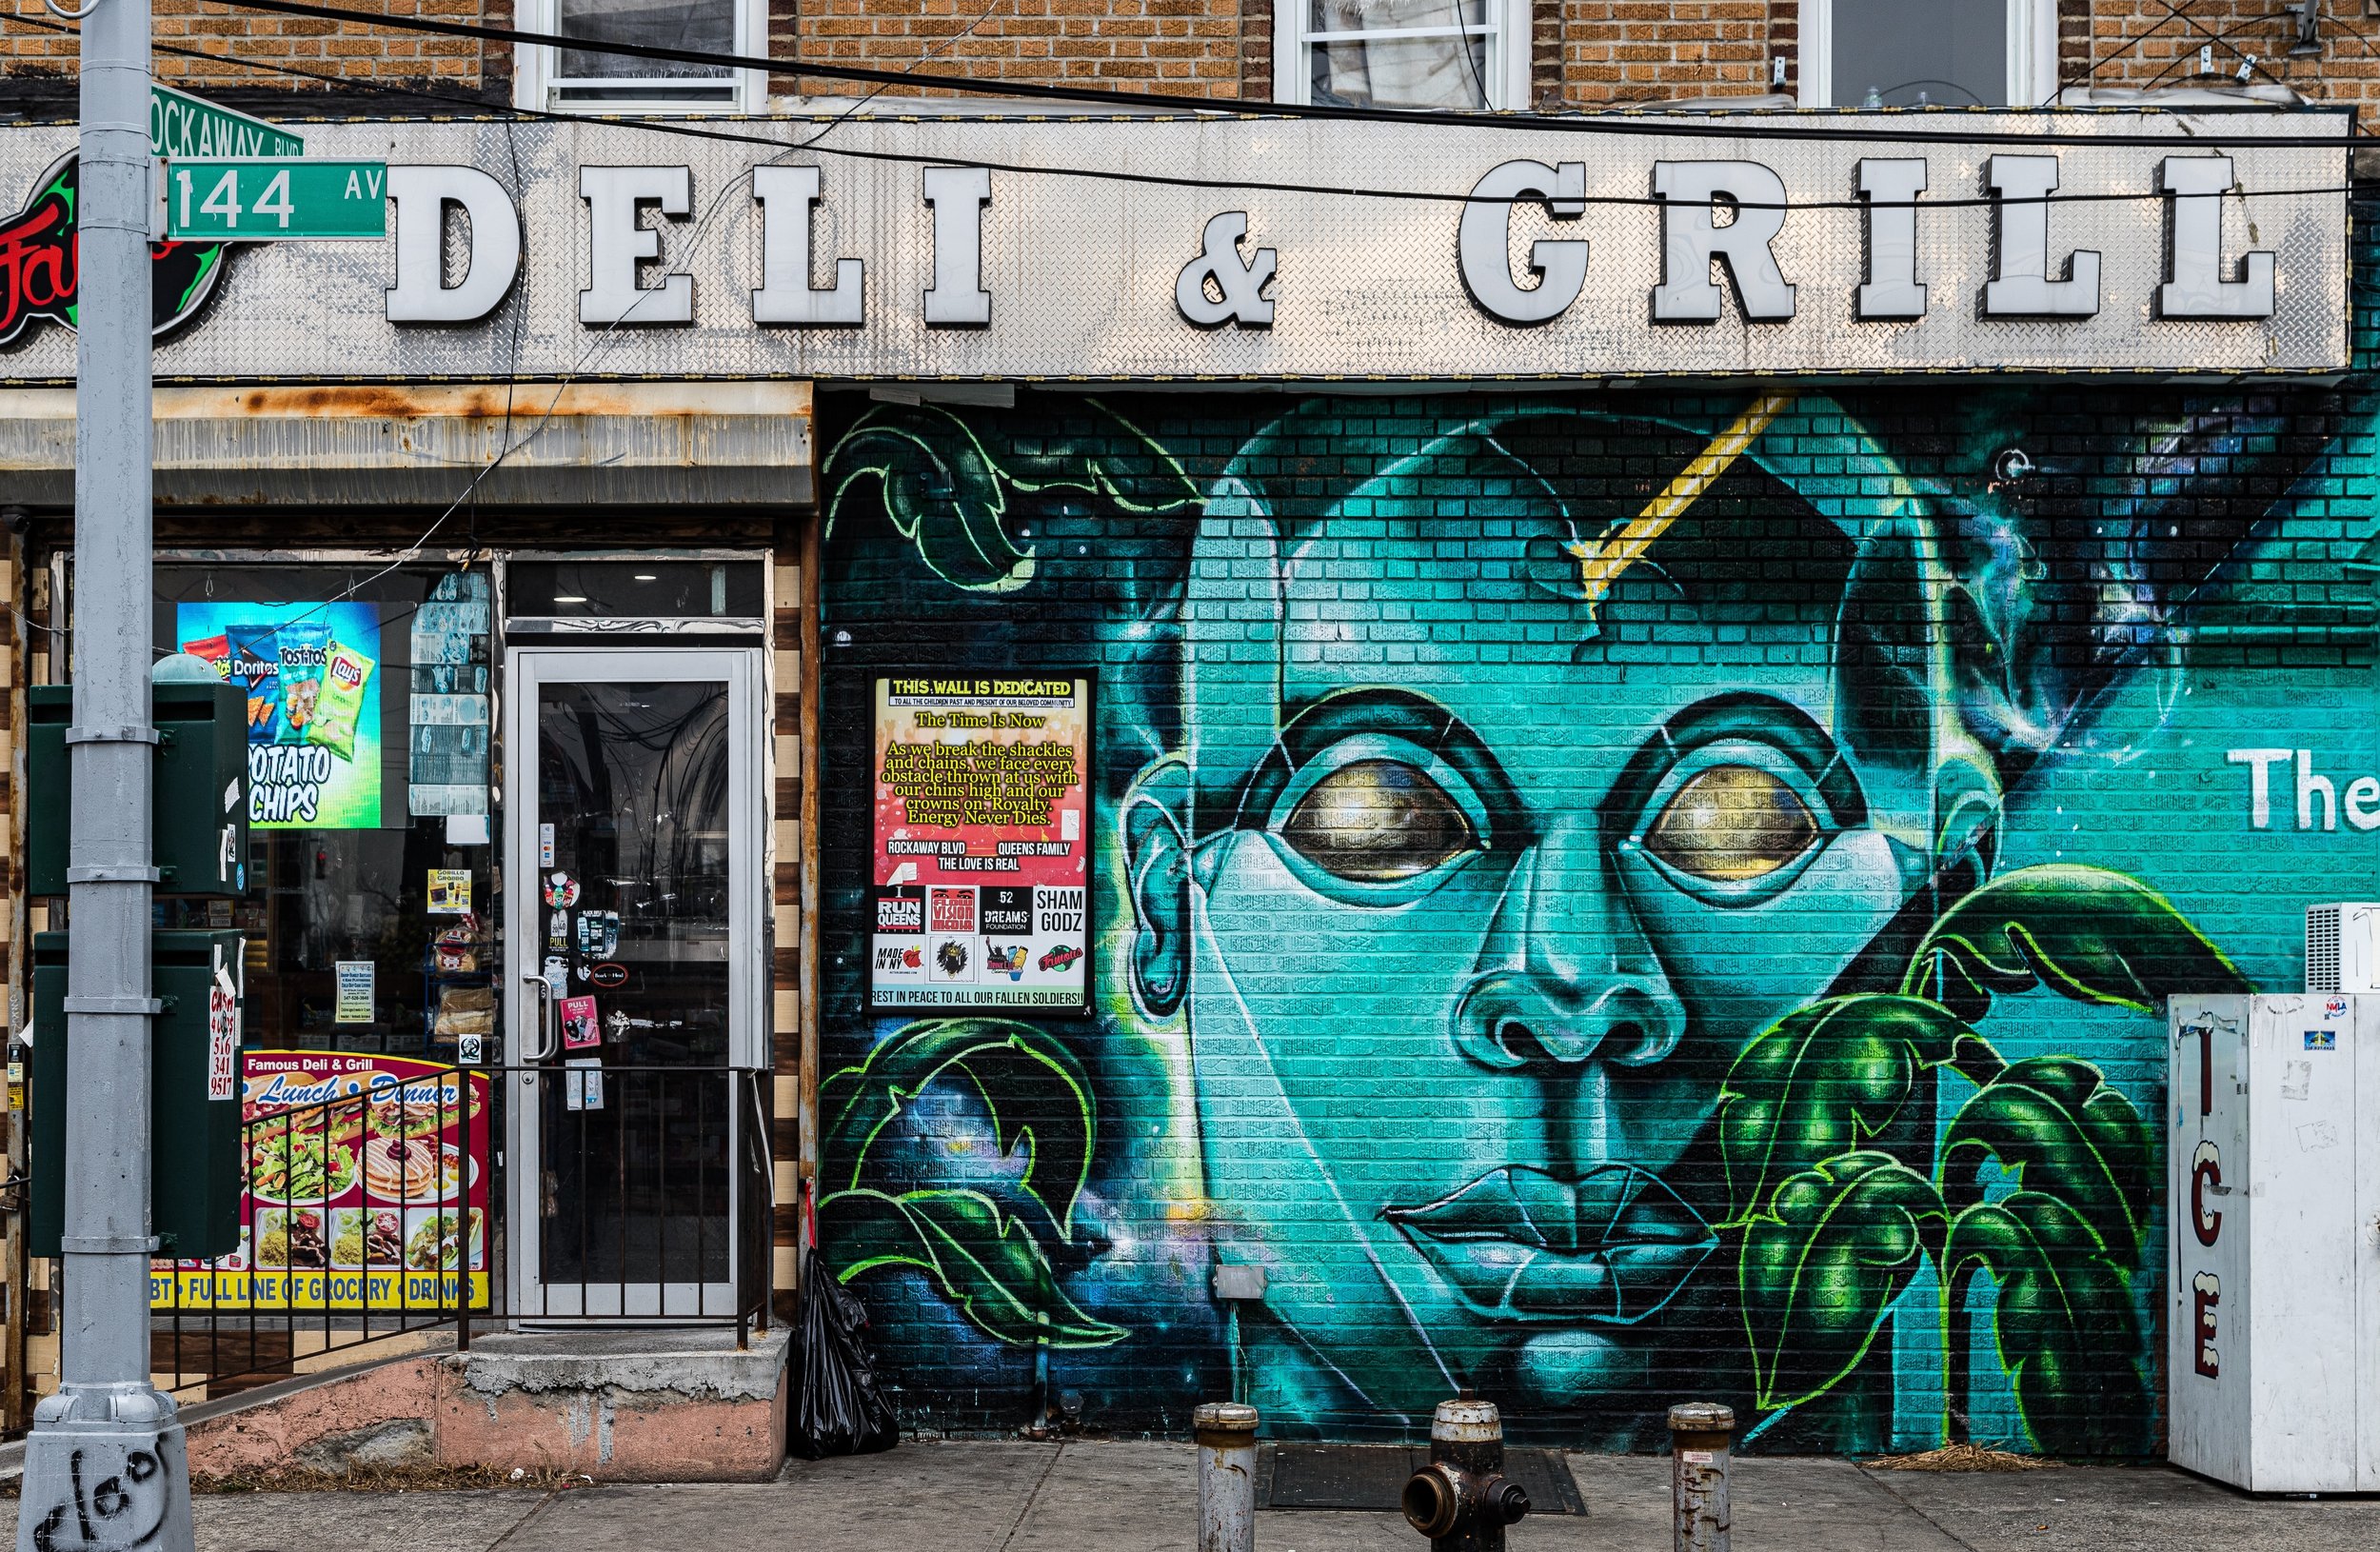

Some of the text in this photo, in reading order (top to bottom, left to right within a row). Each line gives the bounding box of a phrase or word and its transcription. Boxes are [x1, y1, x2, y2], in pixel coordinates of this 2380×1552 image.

[151, 93, 299, 156] OCKAWAY BLVD
[176, 169, 382, 228] 144 AV
[385, 154, 2276, 327] DELI & GRILL
[234, 659, 279, 676] Doritos
[893, 680, 1071, 696] THIS WALL IS DEDICATED
[915, 712, 1045, 727] The Time Is Now
[888, 742, 1073, 757] As we break the shackles
[248, 746, 331, 784] OTATO
[886, 756, 1075, 774] and chains, we face every
[882, 769, 1078, 785] obstacle thrown at us with
[895, 783, 1065, 800] our chins high and our
[2226, 748, 2380, 831] The
[248, 783, 319, 822] CHIPS
[905, 798, 1053, 814] crowns on. Royalty.
[907, 811, 1051, 826] Energy Never Dies.
[887, 841, 1071, 856] ROCKAWAY BLVD QUEENS FAMILY
[938, 858, 1020, 871] THE LOVE IS REAL
[895, 885, 903, 898] I
[1000, 891, 1013, 904] 52
[878, 901, 921, 914] RUN
[1037, 890, 1082, 910] SHAM
[878, 913, 921, 926] QUEENS
[933, 905, 973, 920] VISION
[984, 910, 1028, 924] DREAMS
[1041, 912, 1082, 932] GODZ
[549, 937, 567, 946] PULL
[877, 948, 903, 959] MADE
[1039, 946, 1083, 971] Famous
[875, 958, 902, 969] IN NY
[567, 1000, 589, 1009] PULL
[872, 990, 1083, 1005] REST IN PEACE TO ALL OUR FALLEN SOLDIERS!!
[213, 1037, 231, 1054] 516
[213, 1057, 230, 1075] 341
[248, 1059, 373, 1071] Famous Deli & Grill
[210, 1077, 232, 1095] 9517
[257, 1075, 459, 1104] Lunch Dinner
[2191, 1011, 2223, 1380] ICE
[149, 1278, 172, 1301] BT
[281, 1278, 304, 1301] OF
[308, 1278, 392, 1302] GROCERY
